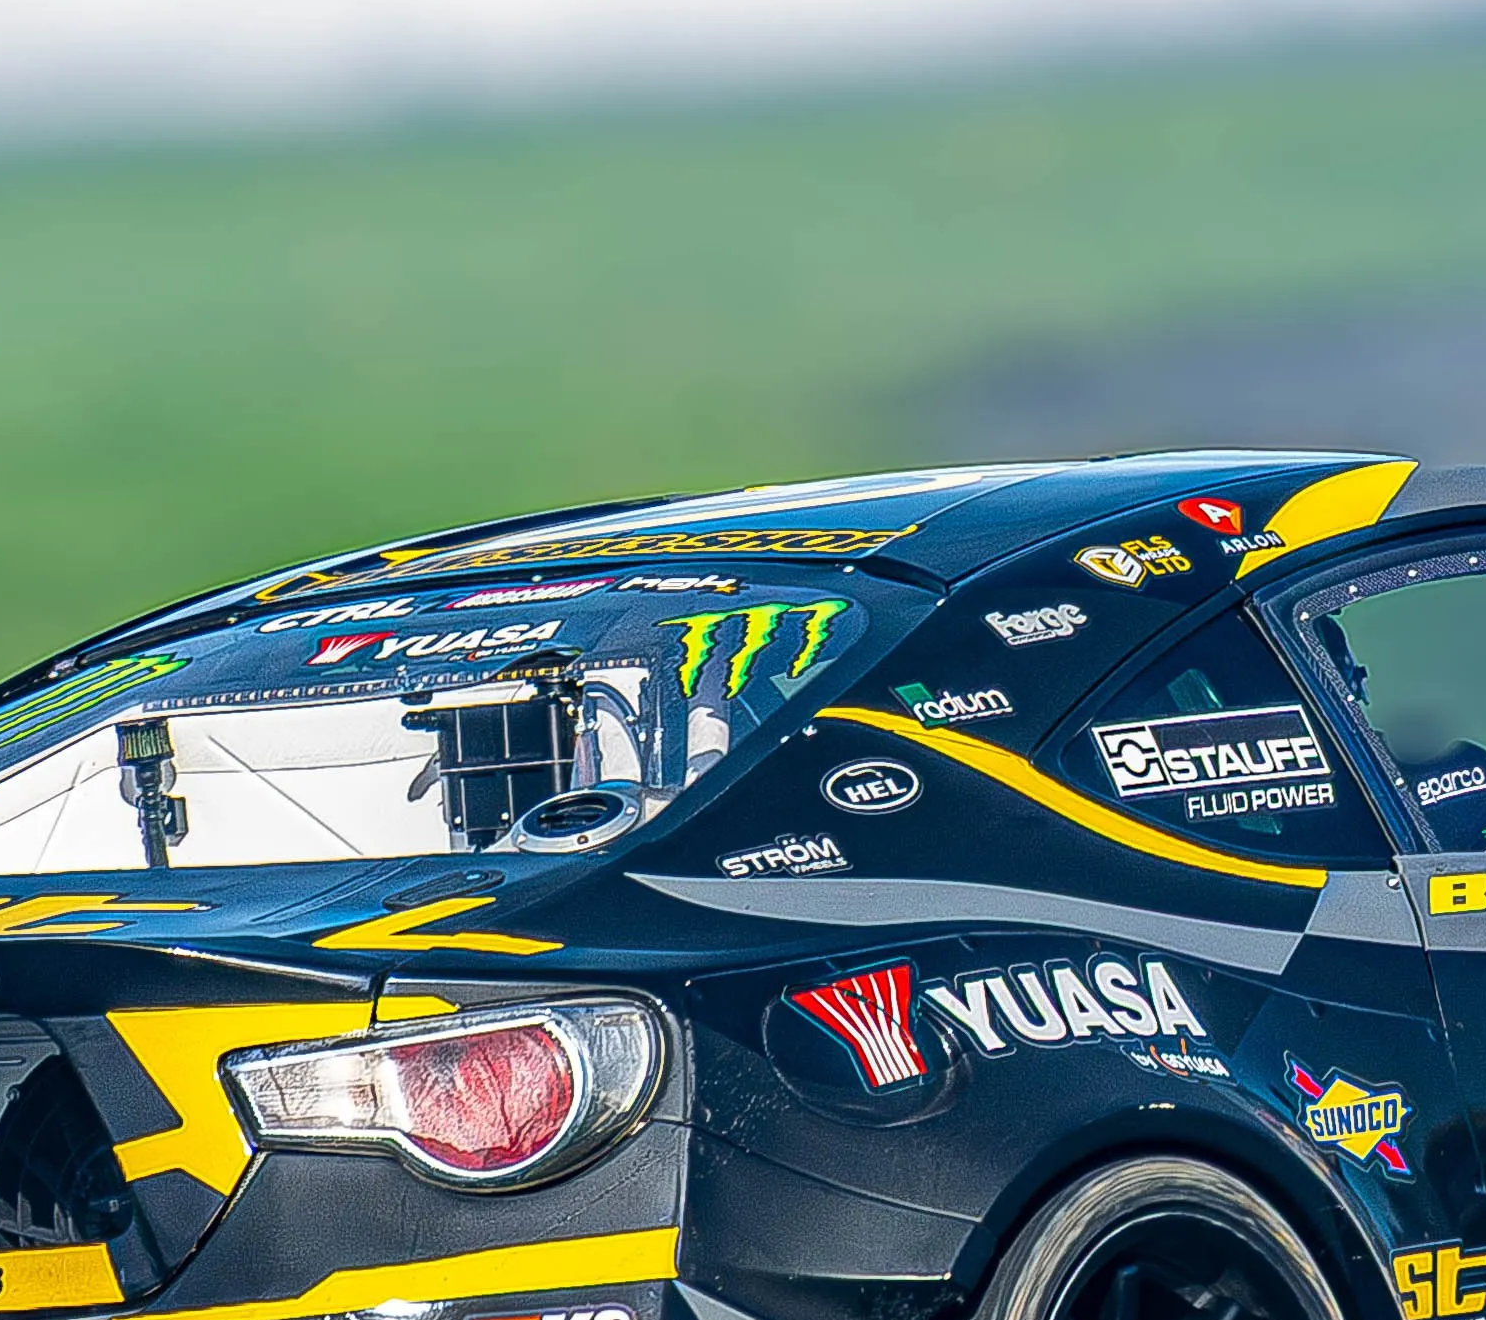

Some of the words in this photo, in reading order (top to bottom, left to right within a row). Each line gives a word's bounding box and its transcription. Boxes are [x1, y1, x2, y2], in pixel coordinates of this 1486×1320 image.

[1120, 536, 1171, 555] FLS
[1220, 531, 1282, 554] ARLON
[1144, 556, 1191, 575] LTD
[259, 598, 415, 633] CTRL
[374, 620, 565, 660] YUASA
[914, 689, 1011, 722] radium
[1169, 736, 1324, 782] STAUFF
[844, 778, 908, 803] HEL
[1187, 791, 1248, 819] FLUID
[1252, 783, 1334, 810] POWER
[1417, 765, 1486, 803] sparco
[924, 961, 1208, 1051] YUASA
[1309, 1099, 1399, 1138] SUNOCO
